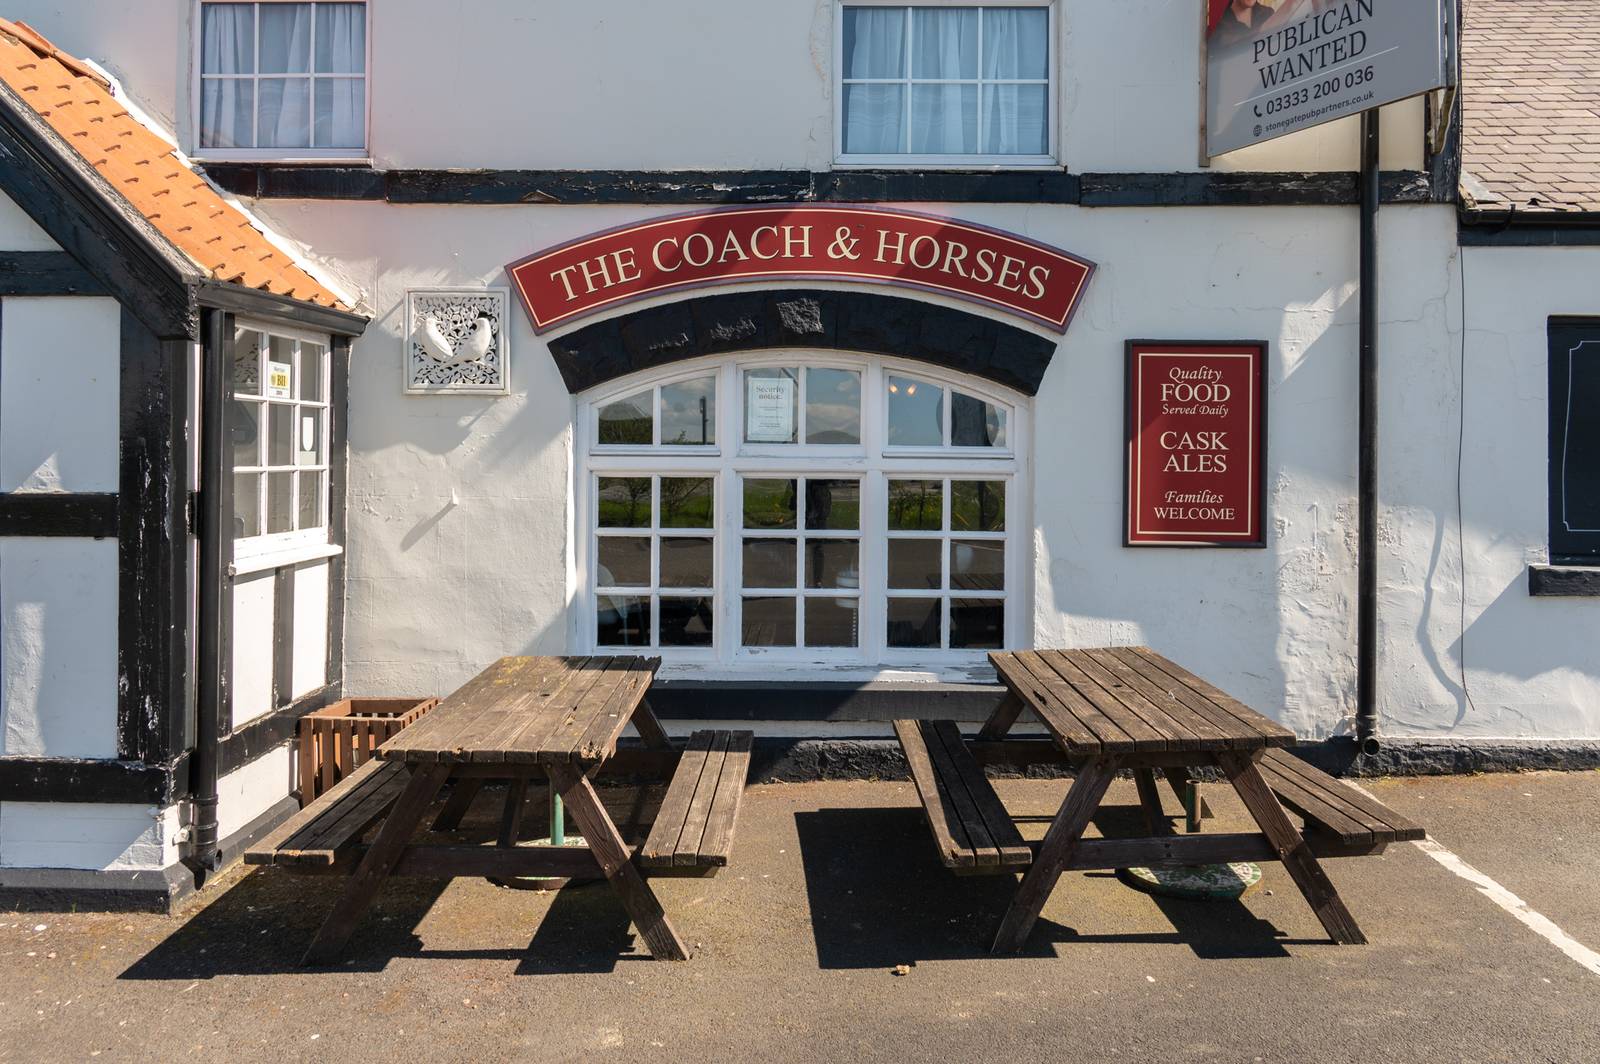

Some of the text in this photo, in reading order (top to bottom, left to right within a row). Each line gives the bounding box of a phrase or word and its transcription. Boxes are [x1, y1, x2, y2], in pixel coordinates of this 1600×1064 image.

[1253, 0, 1374, 64] PUBLICAN
[1258, 30, 1367, 89] WANTED
[1266, 65, 1374, 115] 03333 200 036
[1265, 91, 1374, 131] stonegatepubpartners.co.uk
[550, 225, 1050, 301] THE COACH & HORSES
[1169, 366, 1222, 384] Quality
[1160, 383, 1231, 402] FOOD
[1162, 403, 1229, 418] Served Daily
[1160, 431, 1230, 450] CASK
[1163, 454, 1227, 473] ALES
[1164, 489, 1224, 504] Families
[1154, 507, 1235, 520] WELCOME
